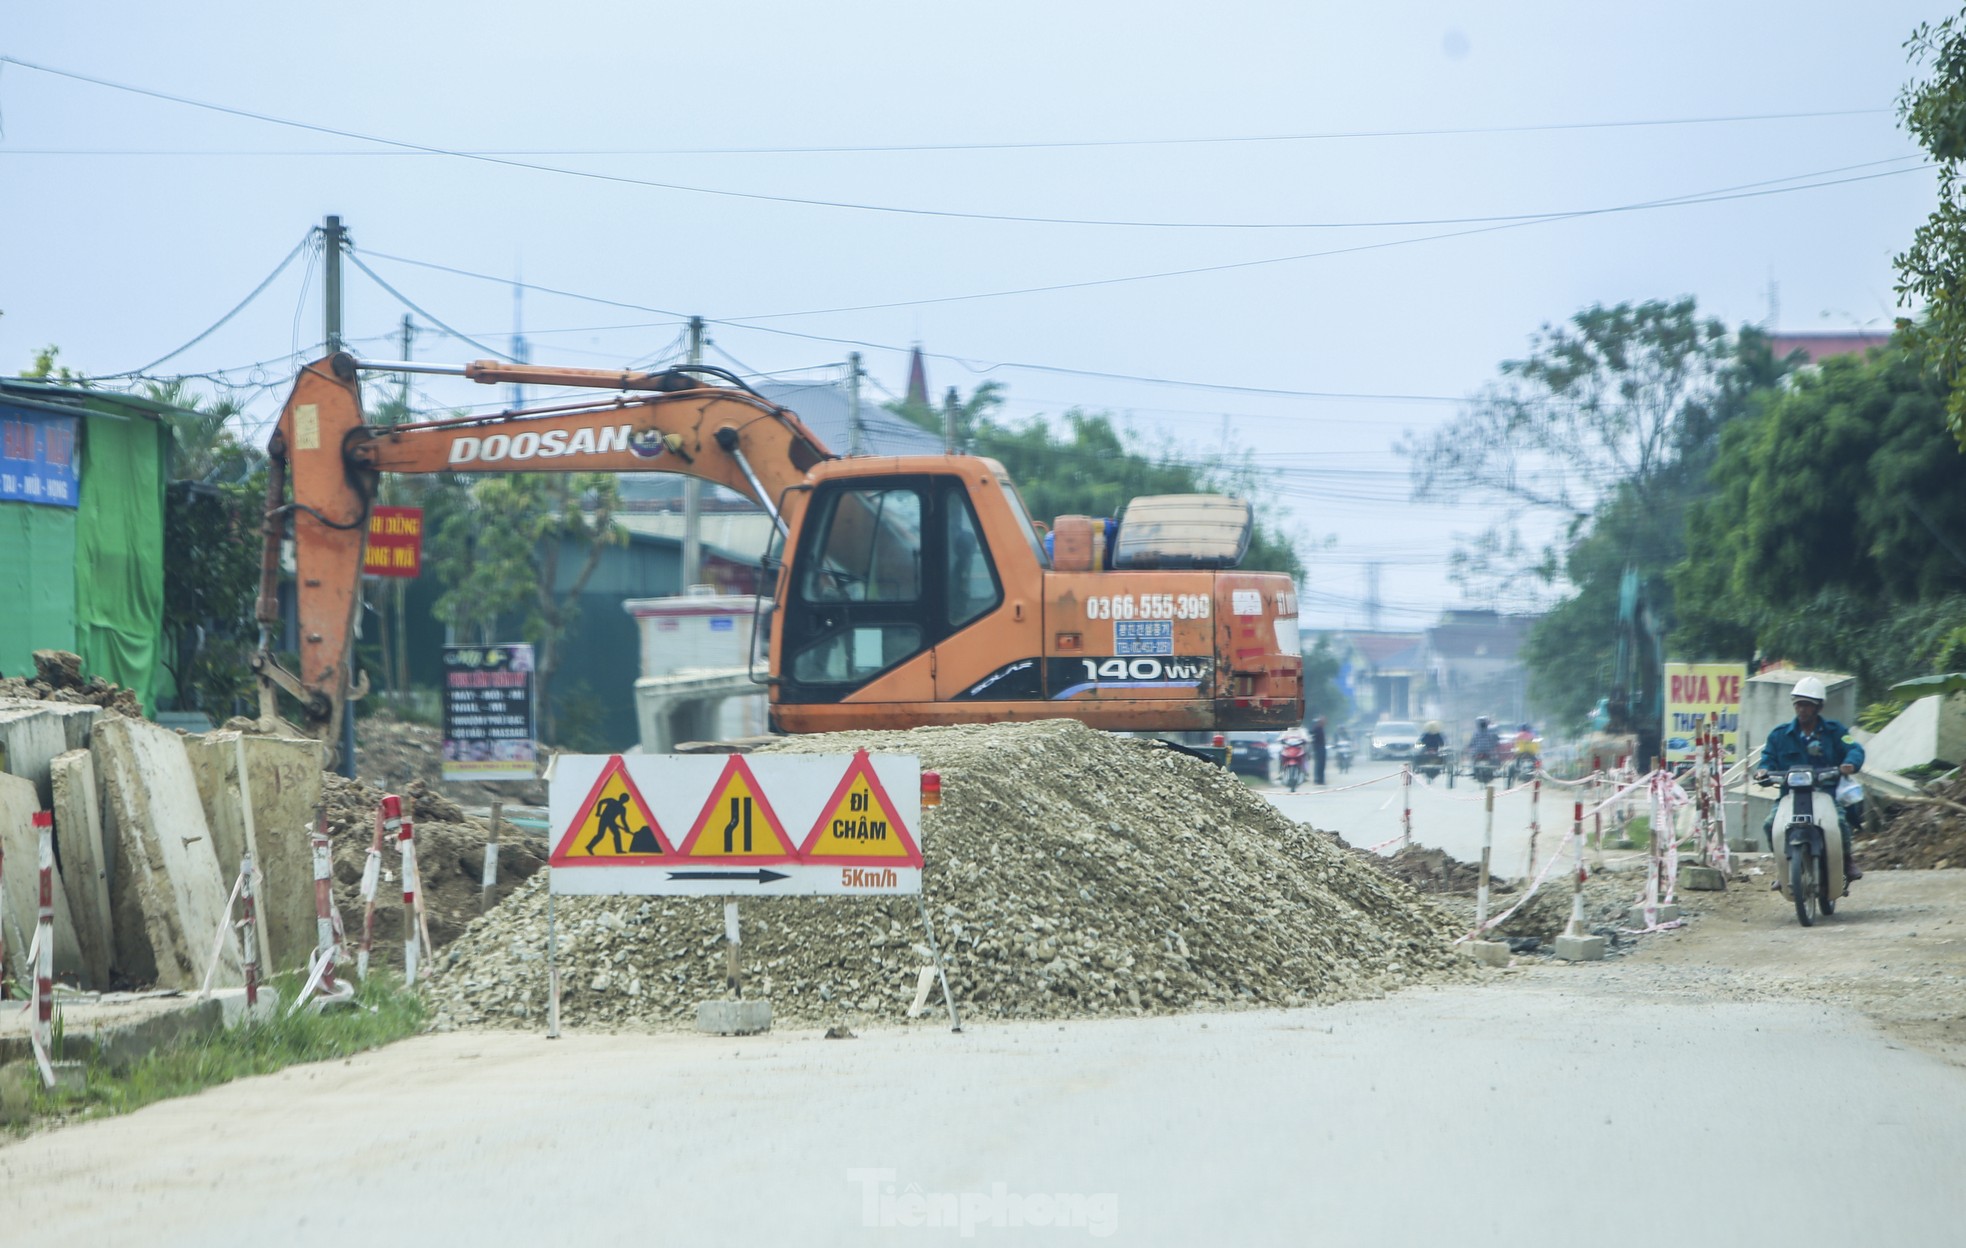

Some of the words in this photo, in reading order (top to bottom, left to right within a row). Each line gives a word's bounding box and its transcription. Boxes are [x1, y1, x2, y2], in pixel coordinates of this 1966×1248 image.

[448, 424, 632, 464] DOOSAN
[1082, 657, 1162, 680] 140
[1716, 675, 1740, 704] XE
[832, 816, 887, 844] CHẬM
[841, 867, 897, 888] 5Km/h
